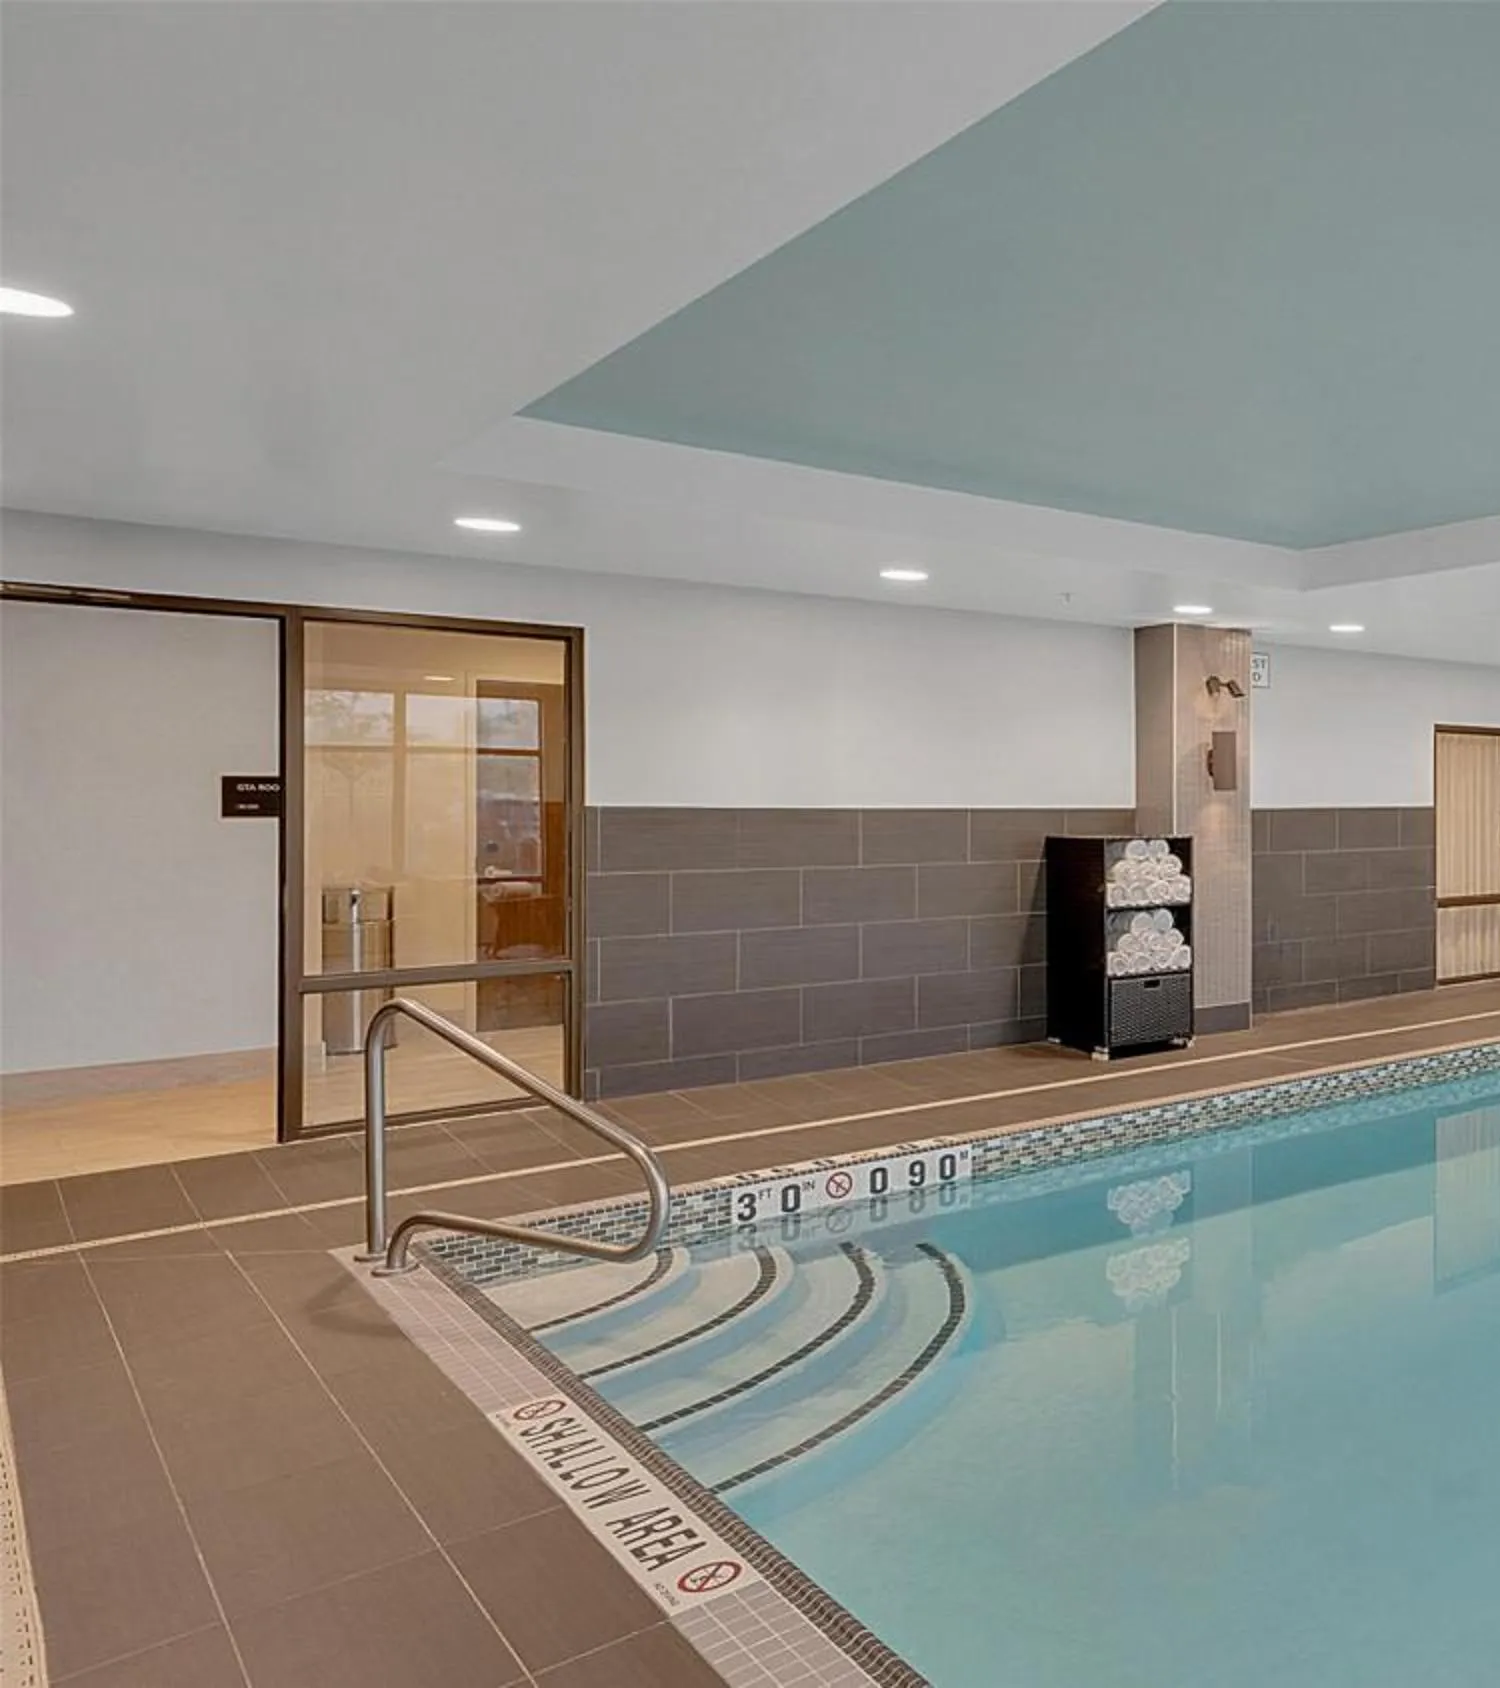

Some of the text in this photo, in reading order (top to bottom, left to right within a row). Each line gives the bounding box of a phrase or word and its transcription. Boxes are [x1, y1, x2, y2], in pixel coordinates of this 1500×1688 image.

[258, 783, 281, 792] ROO
[519, 1416, 707, 1572] SHALLOW AREA
